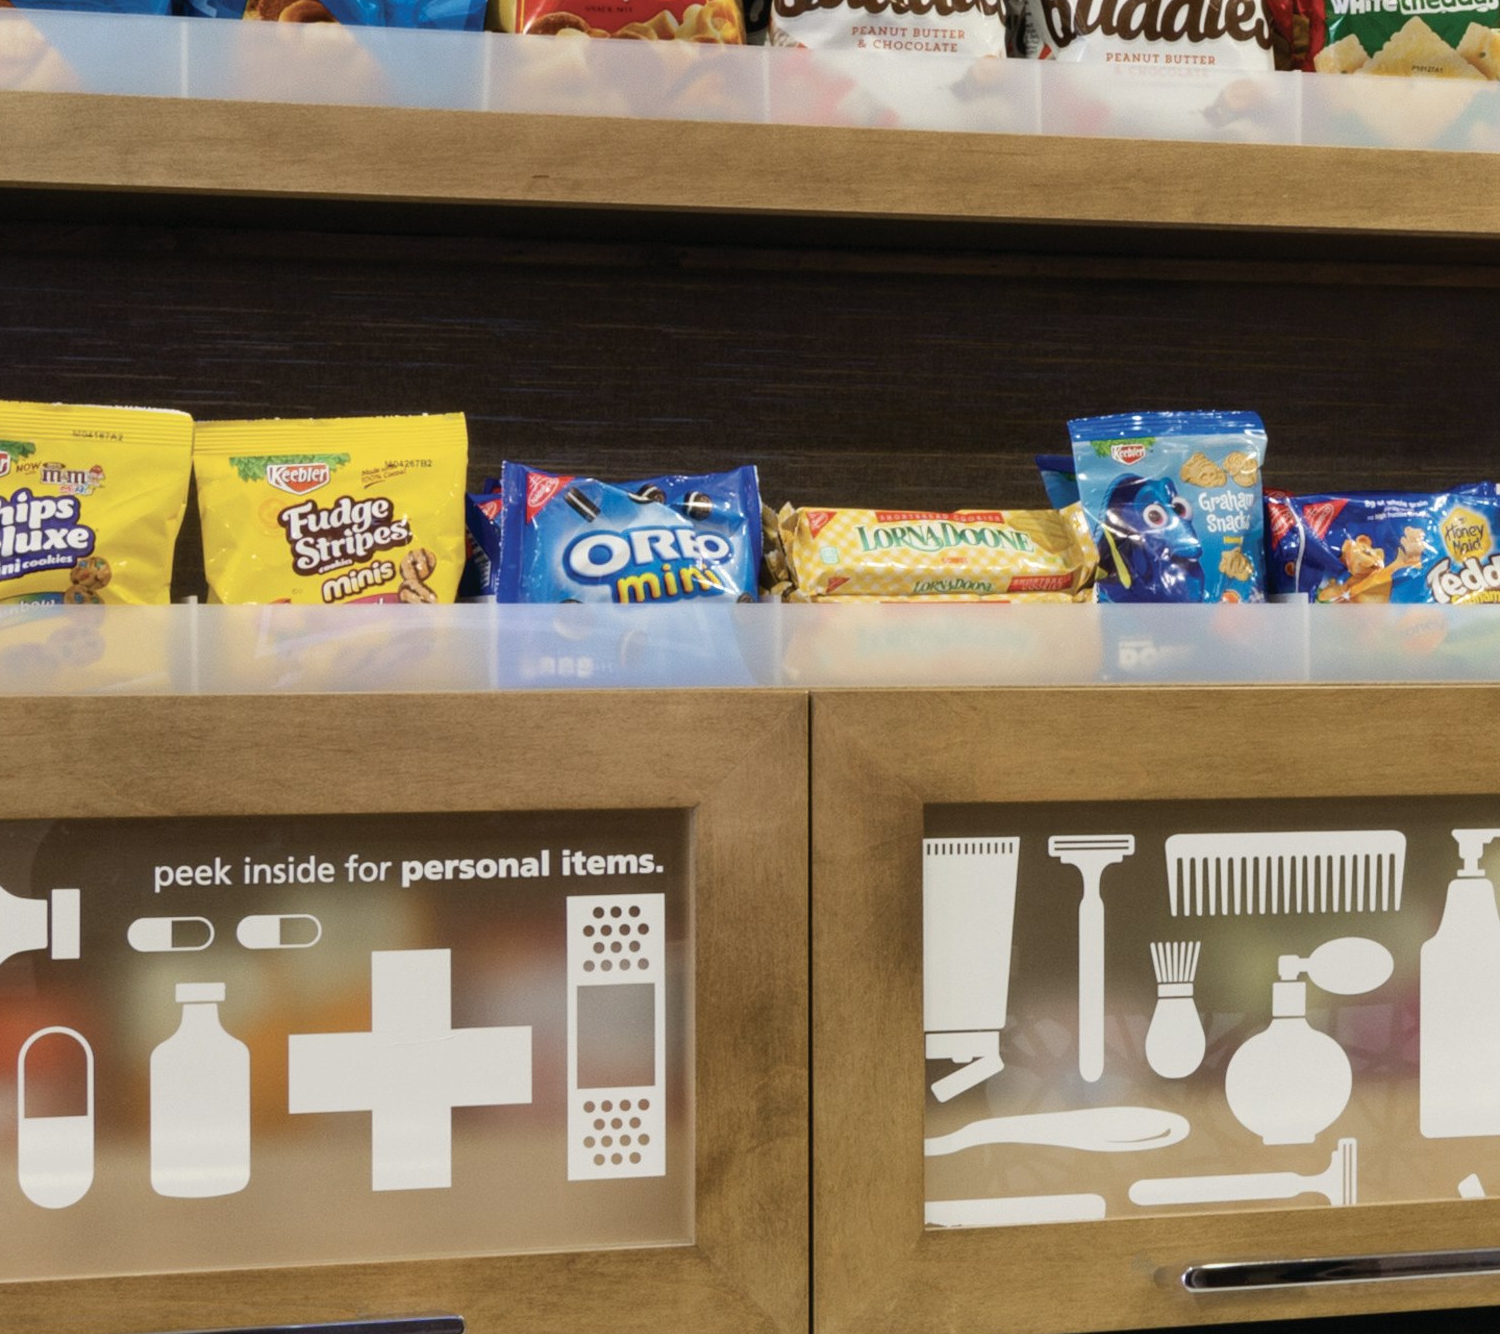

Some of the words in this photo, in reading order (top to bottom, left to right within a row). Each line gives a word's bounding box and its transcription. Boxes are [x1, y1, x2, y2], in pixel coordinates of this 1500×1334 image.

[851, 26, 907, 37] PEANUT
[913, 28, 965, 39] BUTTER
[873, 40, 958, 52] CHOCOLATE
[1106, 52, 1159, 63] PEANUT
[1165, 53, 1216, 65] BUTTER
[269, 466, 328, 485] Keebler
[282, 497, 390, 540] Fudge
[294, 521, 408, 570] Stripes
[569, 528, 730, 577] OREO
[855, 525, 945, 553] LORNA
[942, 522, 1035, 553] DOONE
[22, 554, 72, 570] cookies
[322, 562, 393, 602] minis
[153, 857, 232, 893] peek
[243, 856, 335, 888] inside
[344, 855, 392, 883] for
[401, 849, 551, 888] personal
[561, 849, 664, 877] items.
